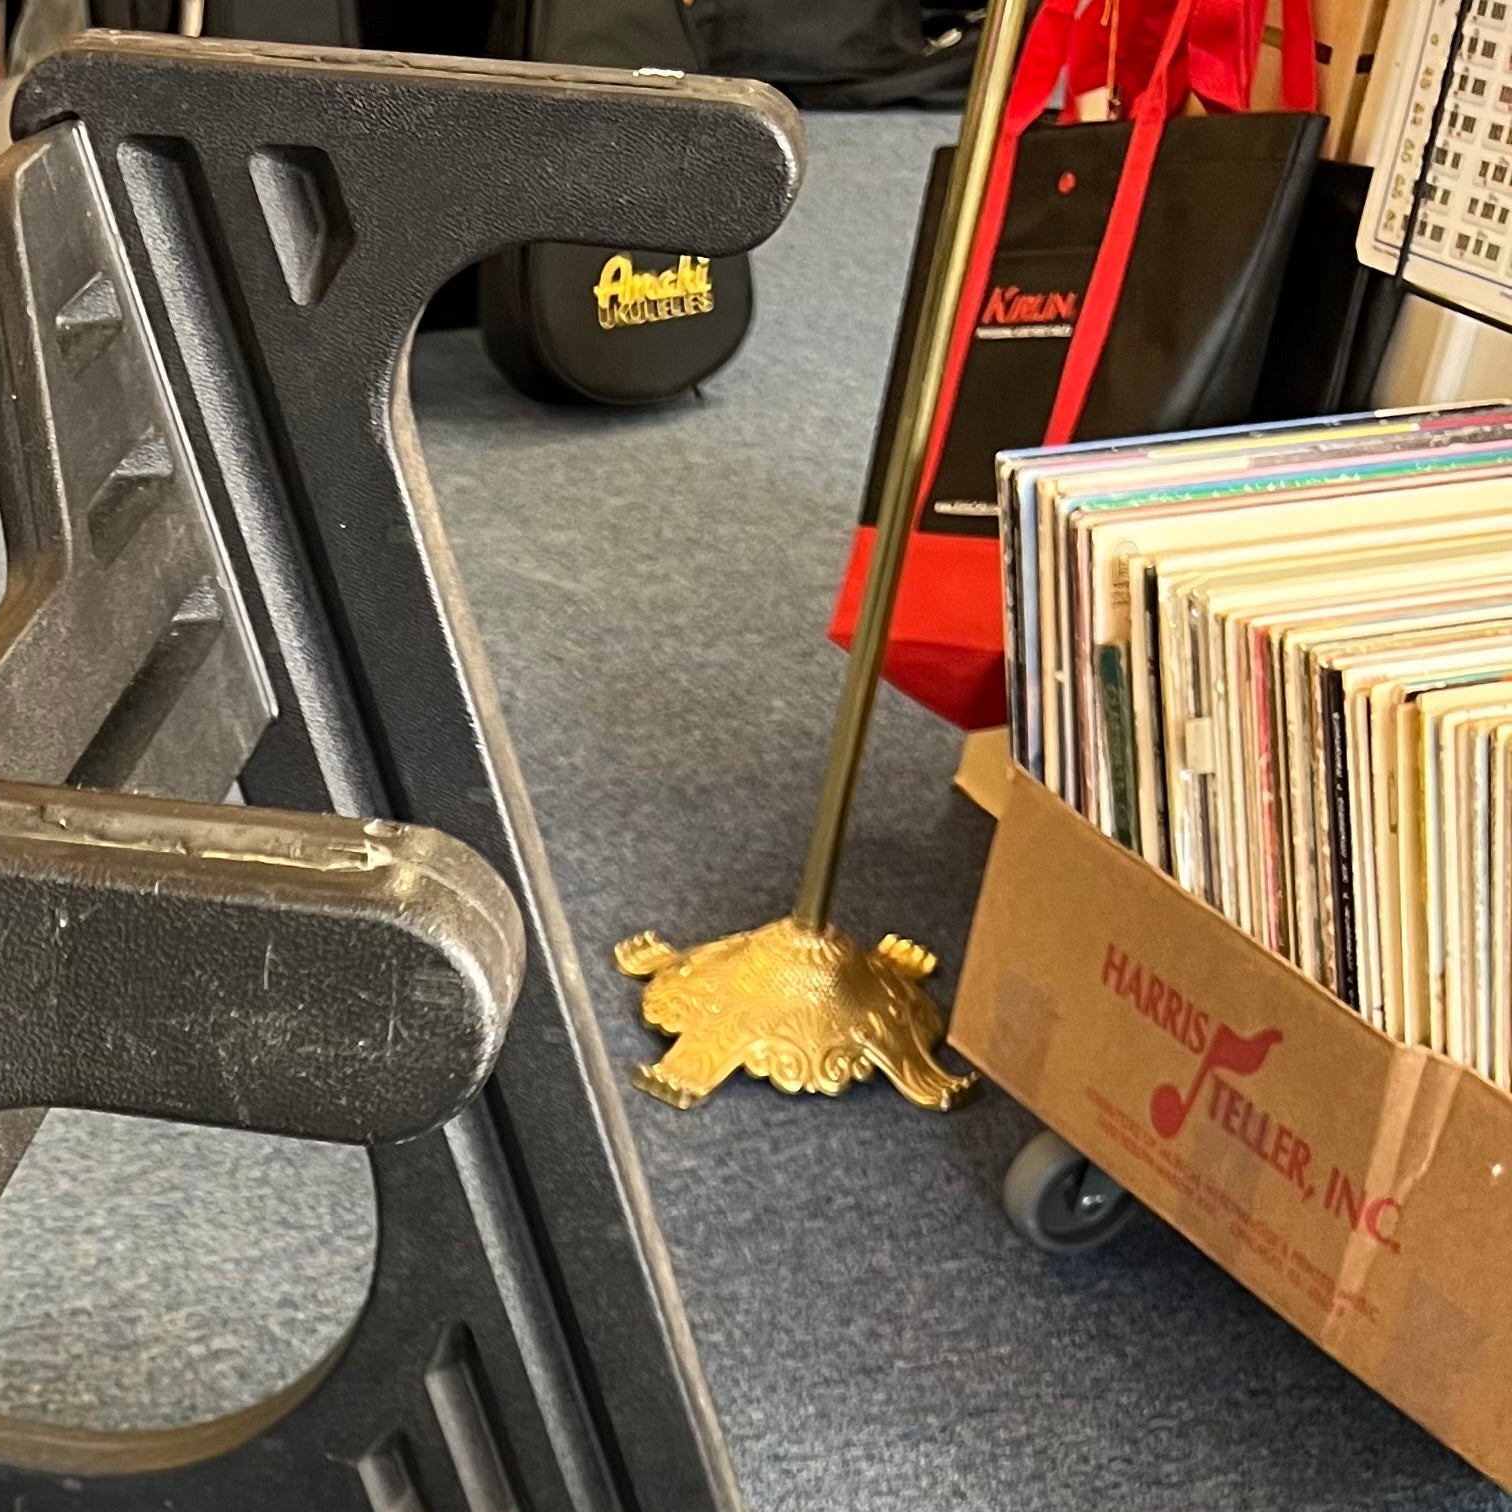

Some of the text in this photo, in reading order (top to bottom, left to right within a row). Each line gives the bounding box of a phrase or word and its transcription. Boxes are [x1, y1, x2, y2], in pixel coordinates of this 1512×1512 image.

[598, 293, 714, 329] UKULELES
[1101, 943, 1210, 1055] HARRIS
[1205, 1078, 1315, 1203] TELLER,
